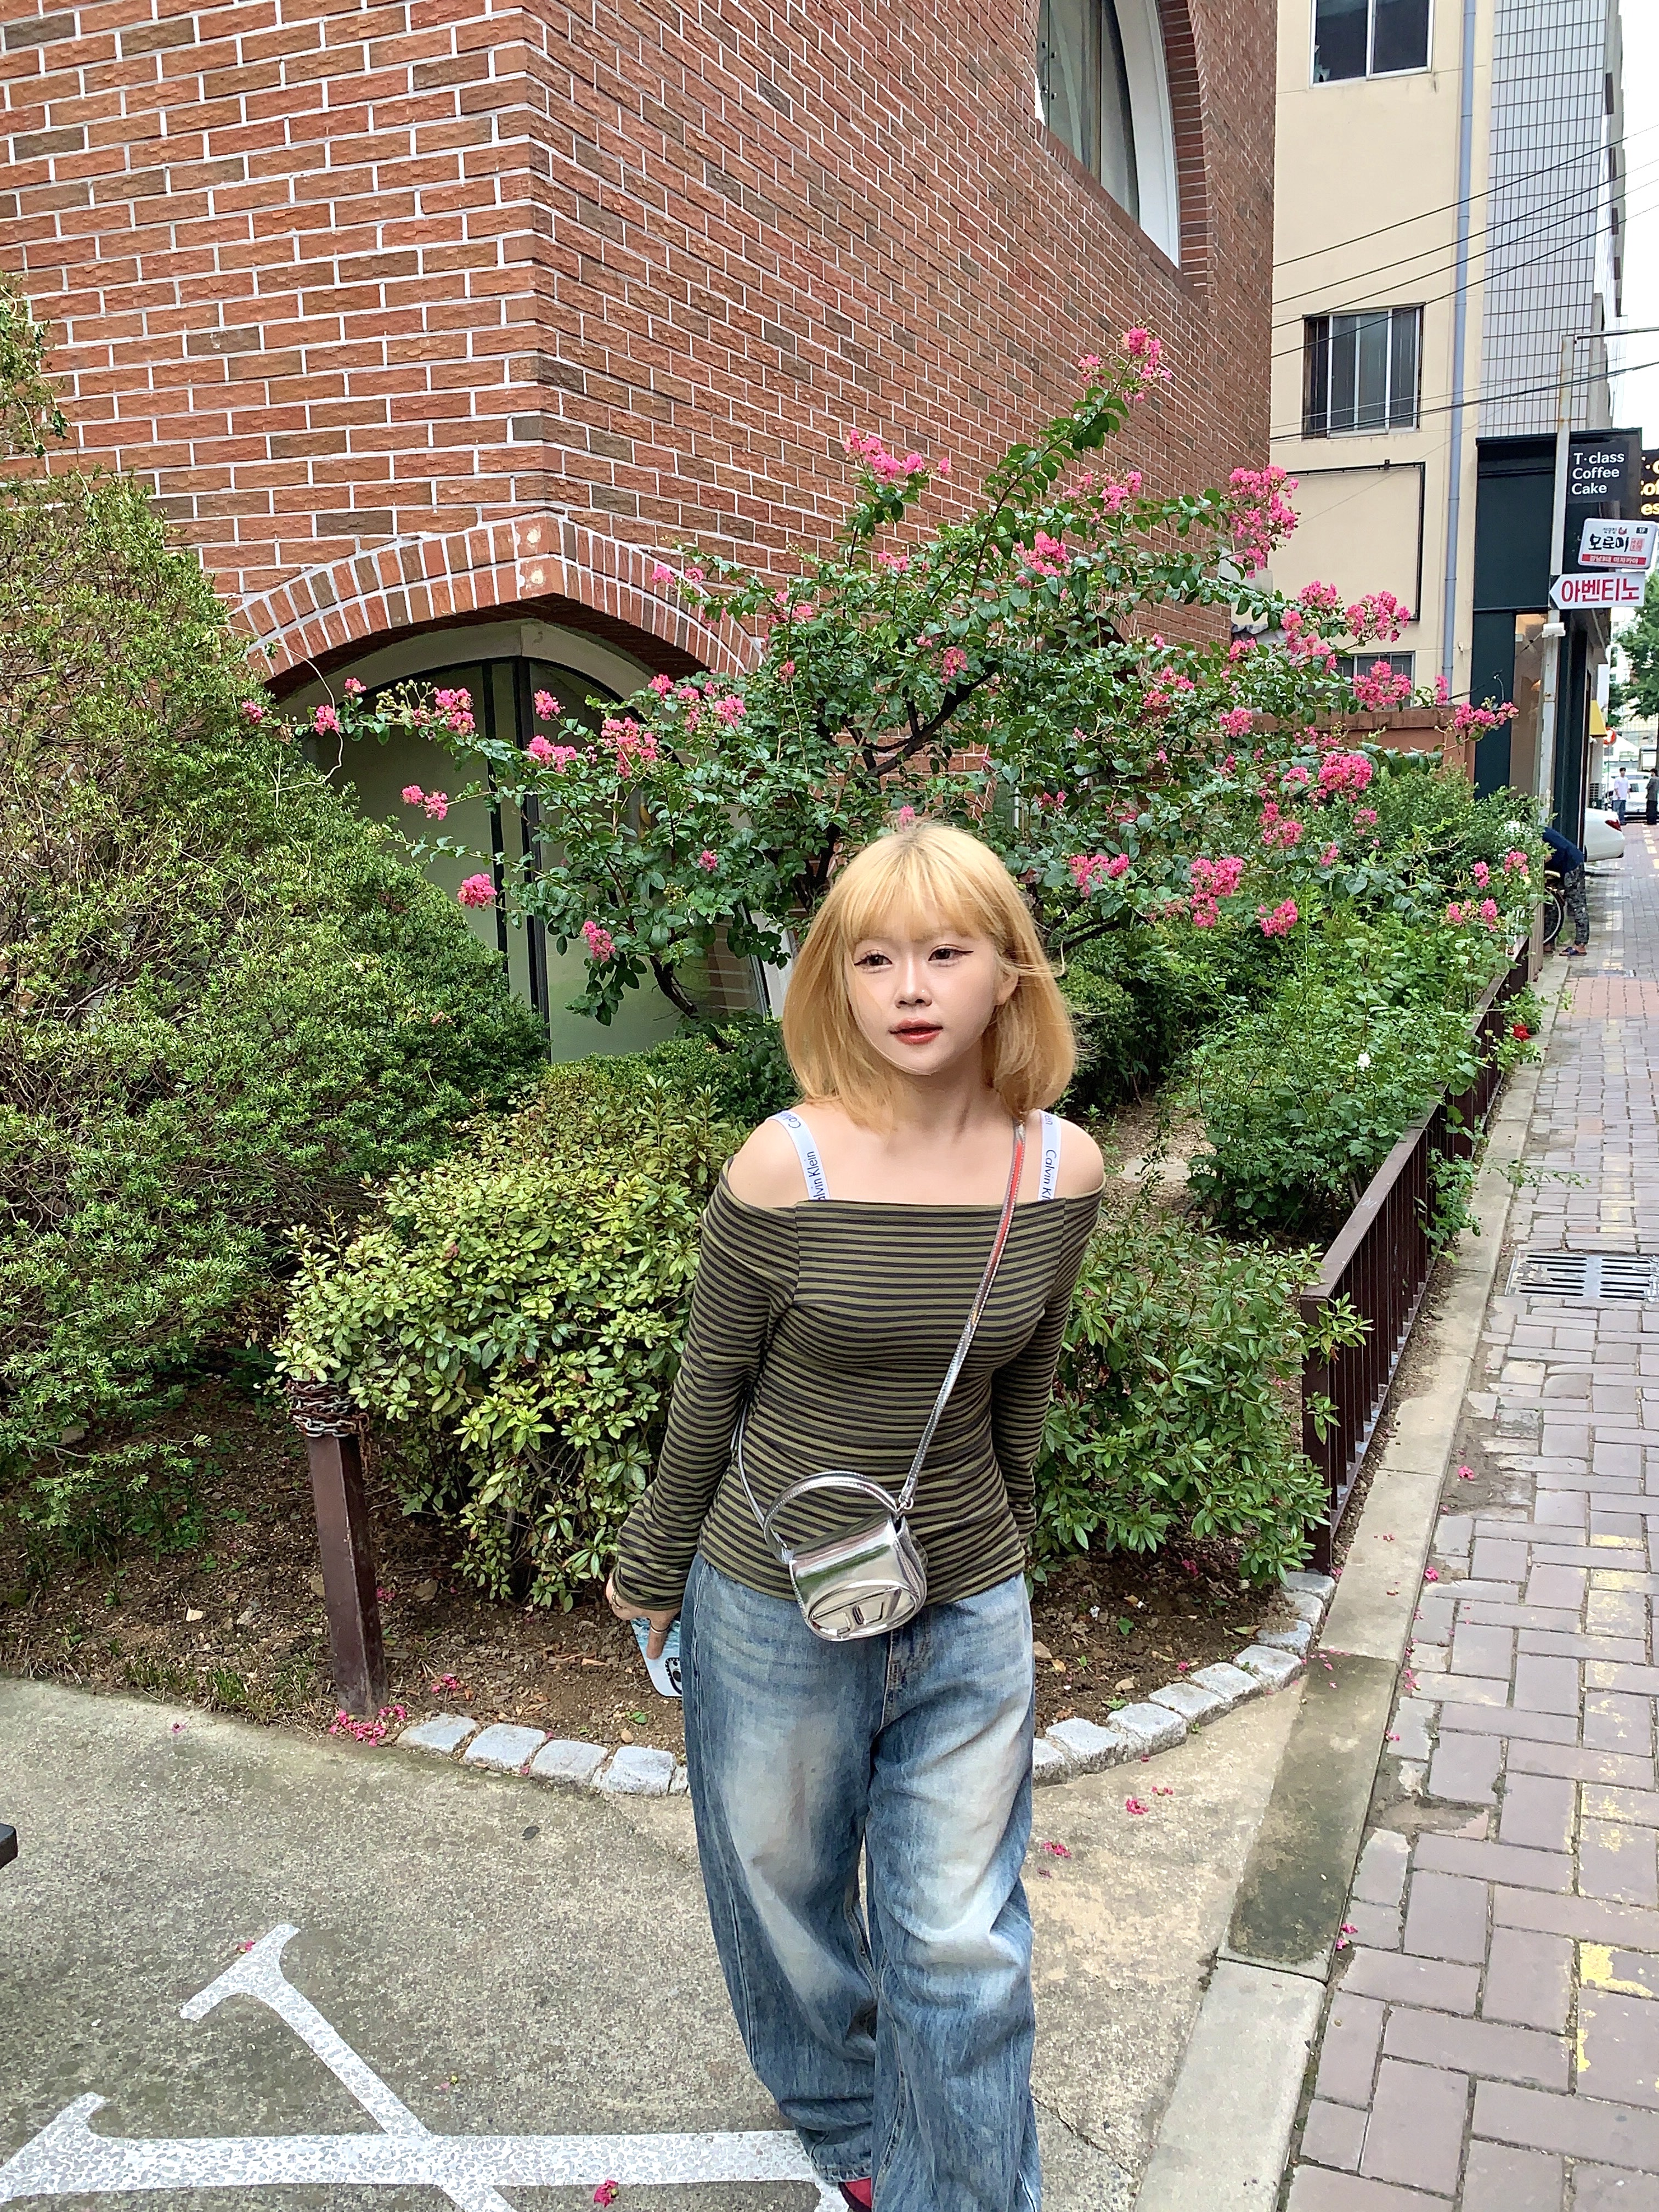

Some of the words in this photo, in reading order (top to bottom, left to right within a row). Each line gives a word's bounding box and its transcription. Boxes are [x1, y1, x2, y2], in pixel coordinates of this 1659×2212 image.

[1572, 466, 1620, 480] Coffee
[1571, 482, 1607, 495] Cake
[1561, 578, 1640, 602] 아벤티노
[805, 1151, 821, 1177] Klein
[1044, 1149, 1057, 1184] Calvin
[811, 1178, 827, 1200] alvin
[1042, 1187, 1052, 1200] Kl
